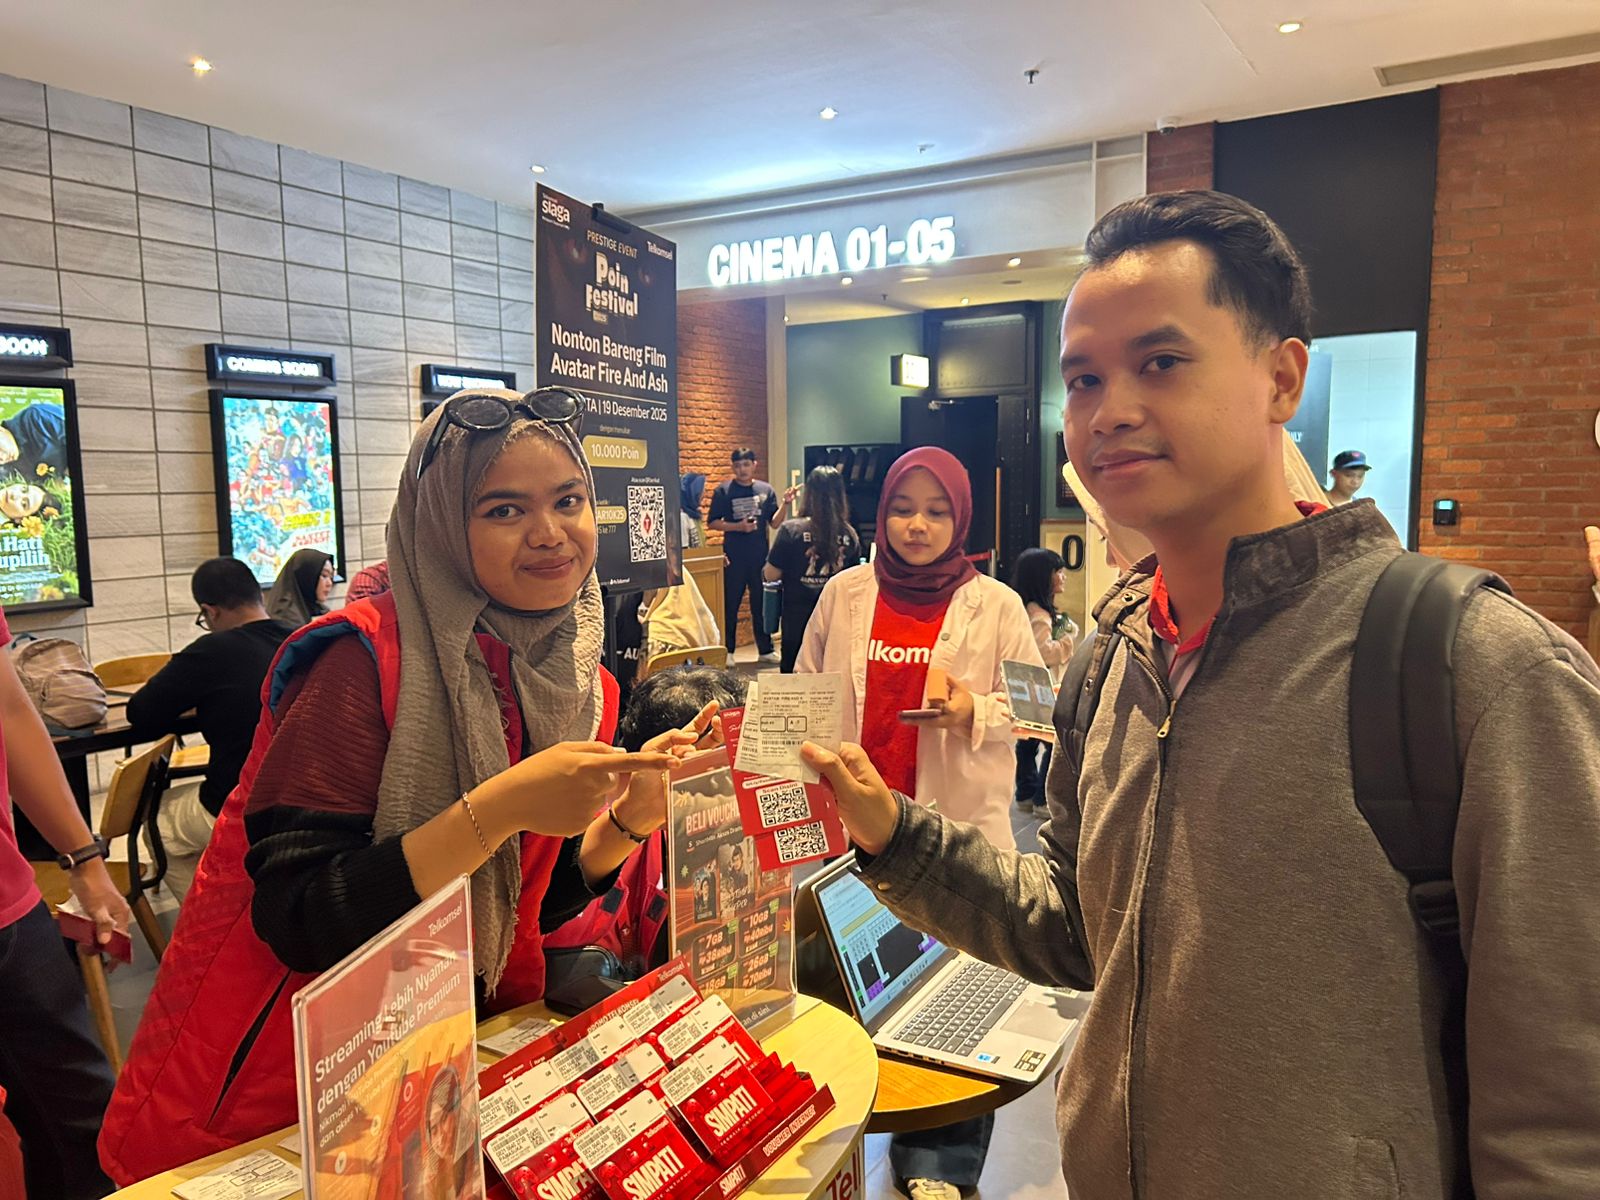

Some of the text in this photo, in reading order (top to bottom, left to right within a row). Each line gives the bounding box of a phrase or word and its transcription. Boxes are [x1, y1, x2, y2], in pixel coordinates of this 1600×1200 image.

[586, 230, 638, 259] PRESTIGE EVENT
[708, 216, 956, 287] CINEMA 01-05
[596, 252, 629, 294] Poin
[586, 284, 638, 317] Festival
[552, 323, 666, 368] Nonton Bareng Film
[551, 353, 668, 393] Avatar Fire And Ash
[586, 398, 597, 413] TA
[603, 400, 611, 415] 19
[612, 402, 650, 419] Desember
[650, 407, 667, 421] 2025
[592, 444, 639, 460] 10.000 Poin
[2, 536, 44, 552] Hati
[0, 550, 50, 572] upilih
[686, 810, 706, 835] BELI
[428, 903, 463, 937] Telkomsel
[750, 910, 769, 928] 10GB
[706, 932, 723, 949] 7GB
[748, 953, 769, 972] 26GB
[610, 998, 640, 1021] TELKOMSE
[743, 1016, 751, 1025] an
[316, 1012, 383, 1083] Streaming
[317, 973, 460, 1113] dengan Youtube Premium
[704, 1084, 758, 1136] SIMPATI
[320, 1130, 334, 1148] dan
[644, 1118, 669, 1138] Telkomsel
[762, 1104, 816, 1157] VOUCHER INTERNET
[537, 1158, 594, 1200] SIMPA
[622, 1145, 684, 1200] SIMPATI
[719, 1164, 746, 1196] SIMPATI
